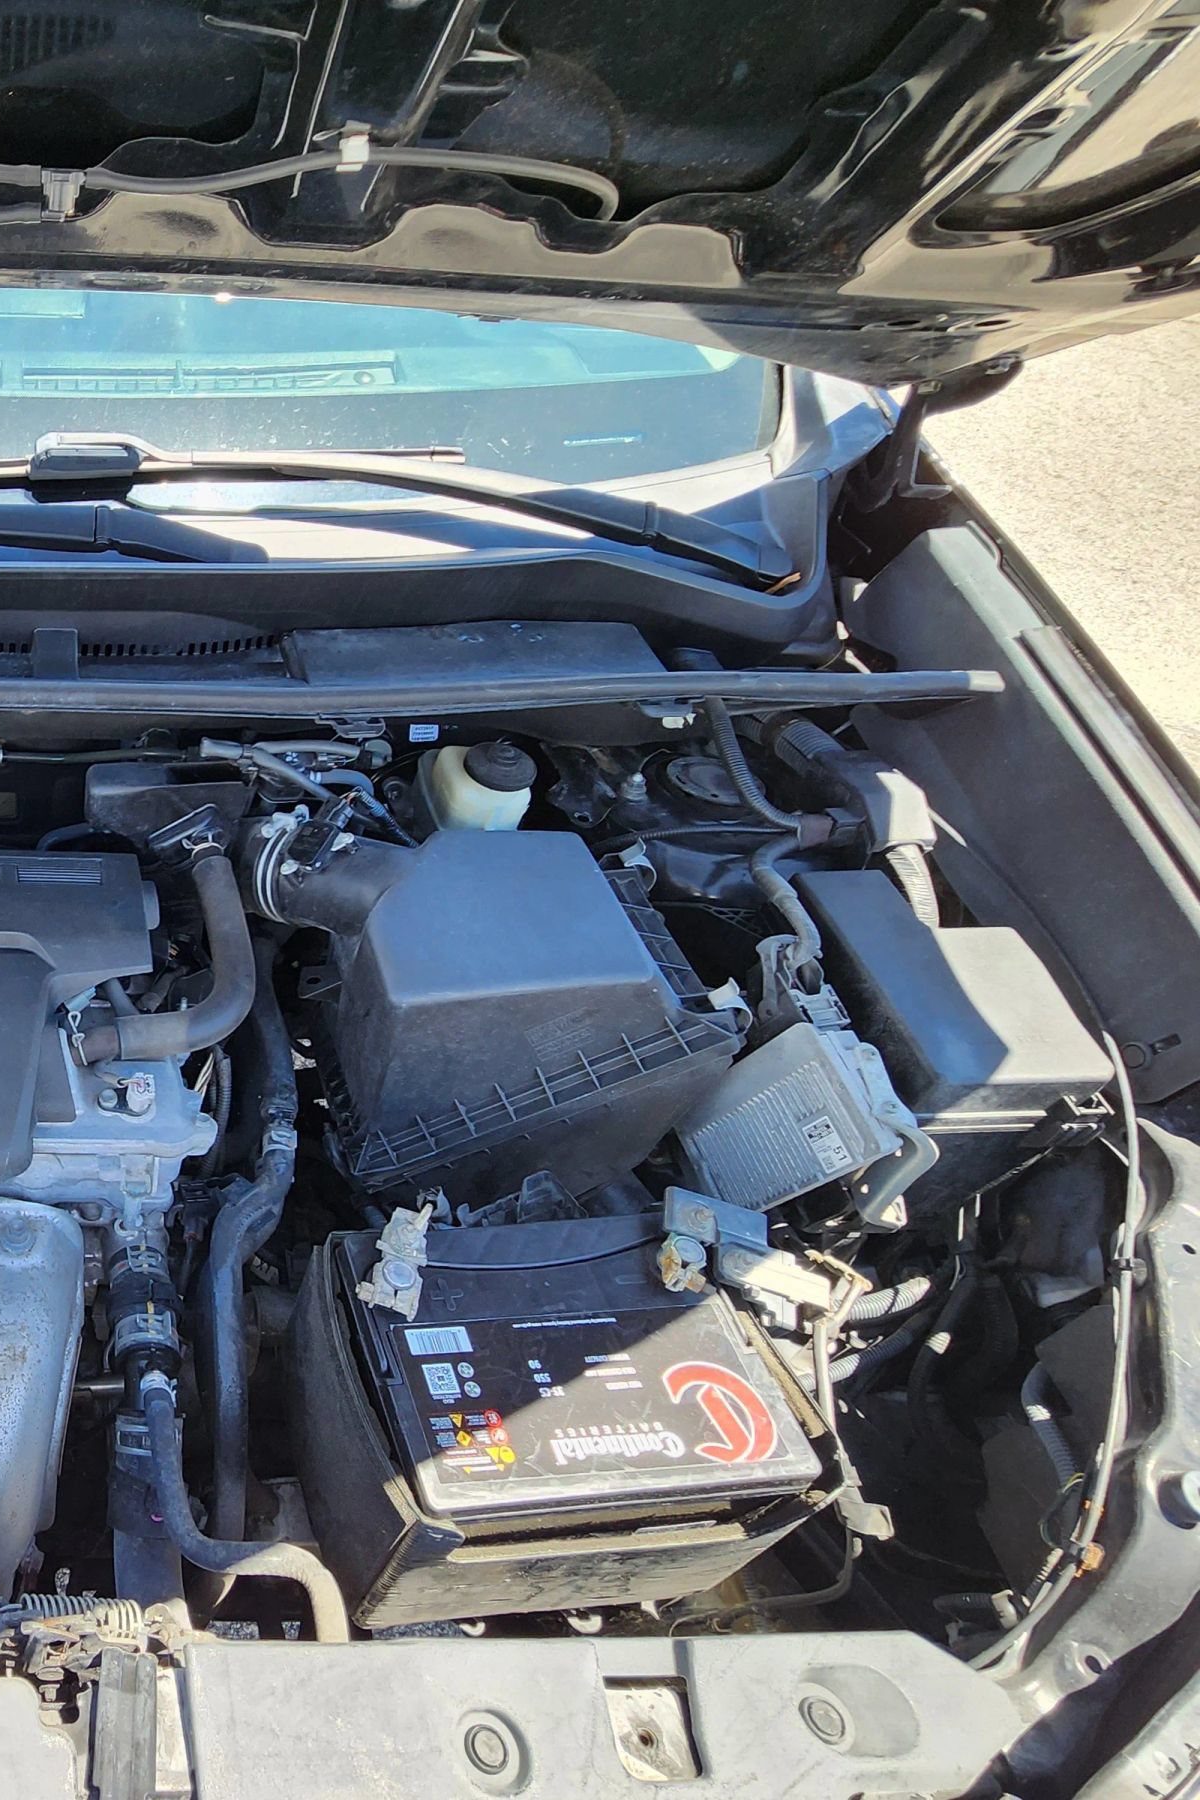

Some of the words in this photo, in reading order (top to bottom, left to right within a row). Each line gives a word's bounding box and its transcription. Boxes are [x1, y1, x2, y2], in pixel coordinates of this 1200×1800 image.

[833, 1146, 847, 1161] 51
[528, 1360, 541, 1370] 90
[534, 1373, 551, 1383] 550
[554, 1422, 663, 1438] BATTERIES
[550, 1431, 686, 1466] Continental
